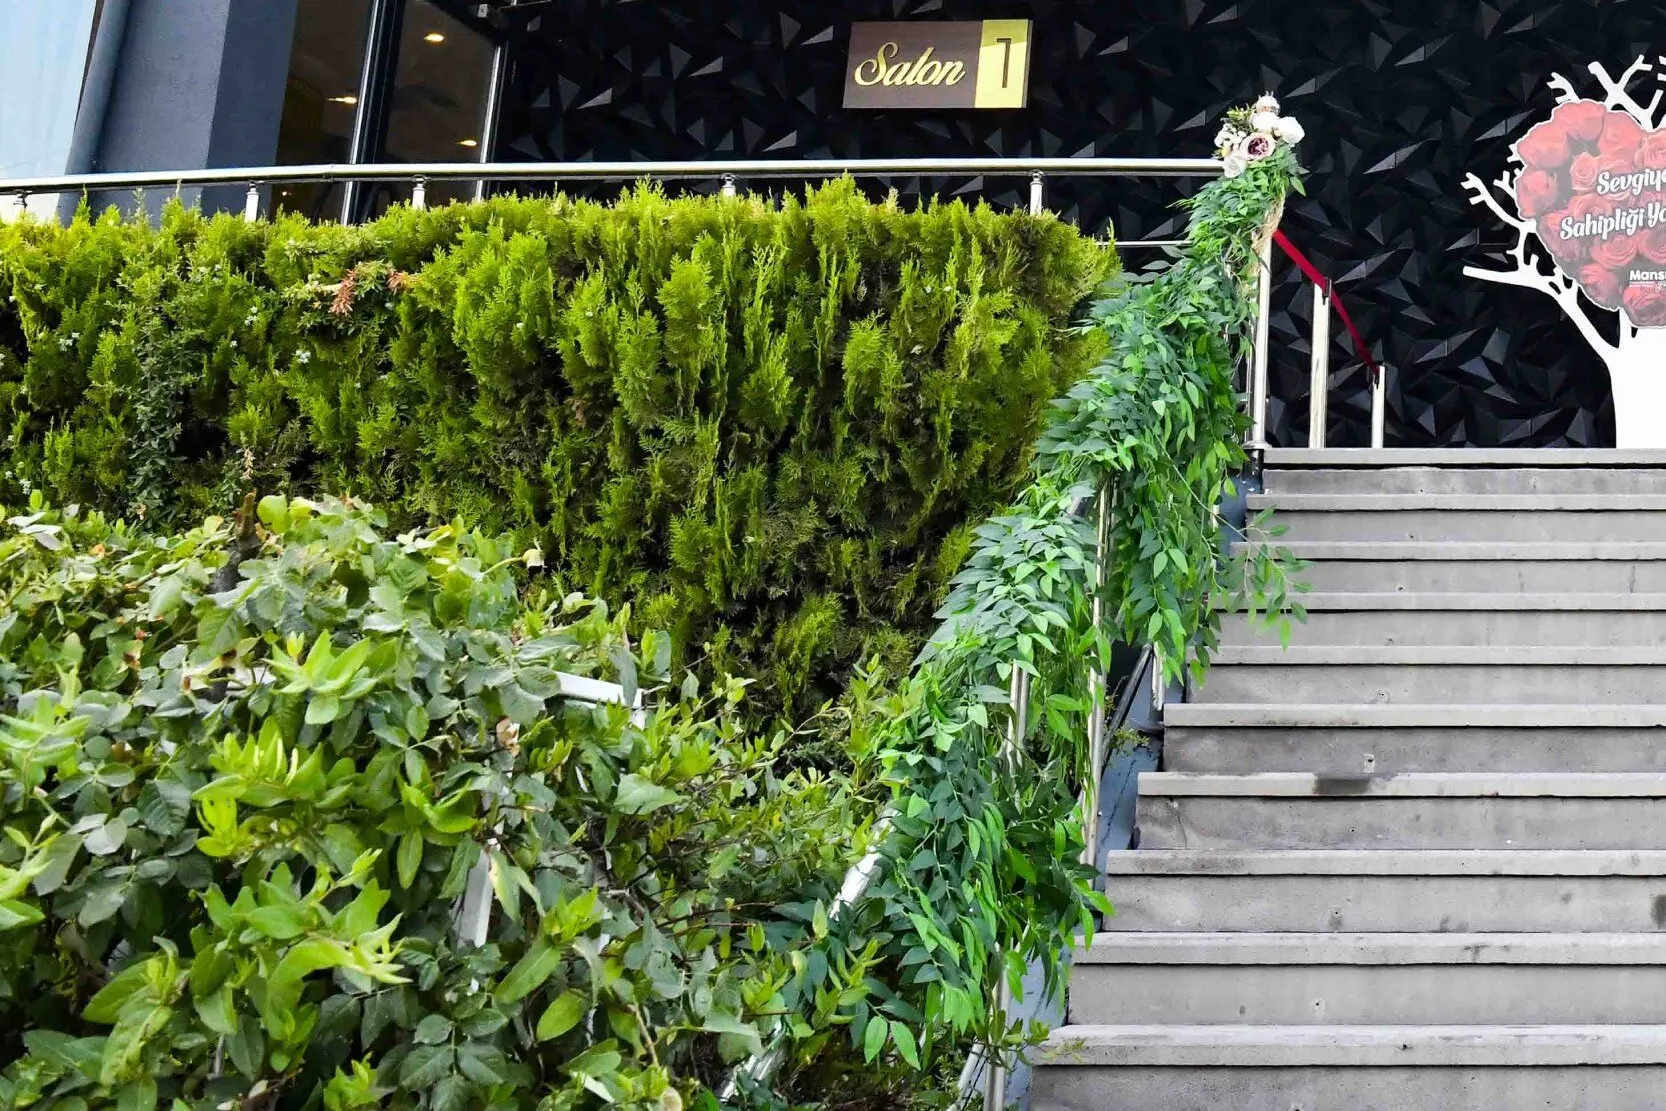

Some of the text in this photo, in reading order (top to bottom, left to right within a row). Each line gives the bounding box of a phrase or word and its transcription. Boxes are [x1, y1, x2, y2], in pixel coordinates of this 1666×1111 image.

[854, 38, 1012, 88] Salon 1
[1559, 208, 1646, 240] Sahipliği
